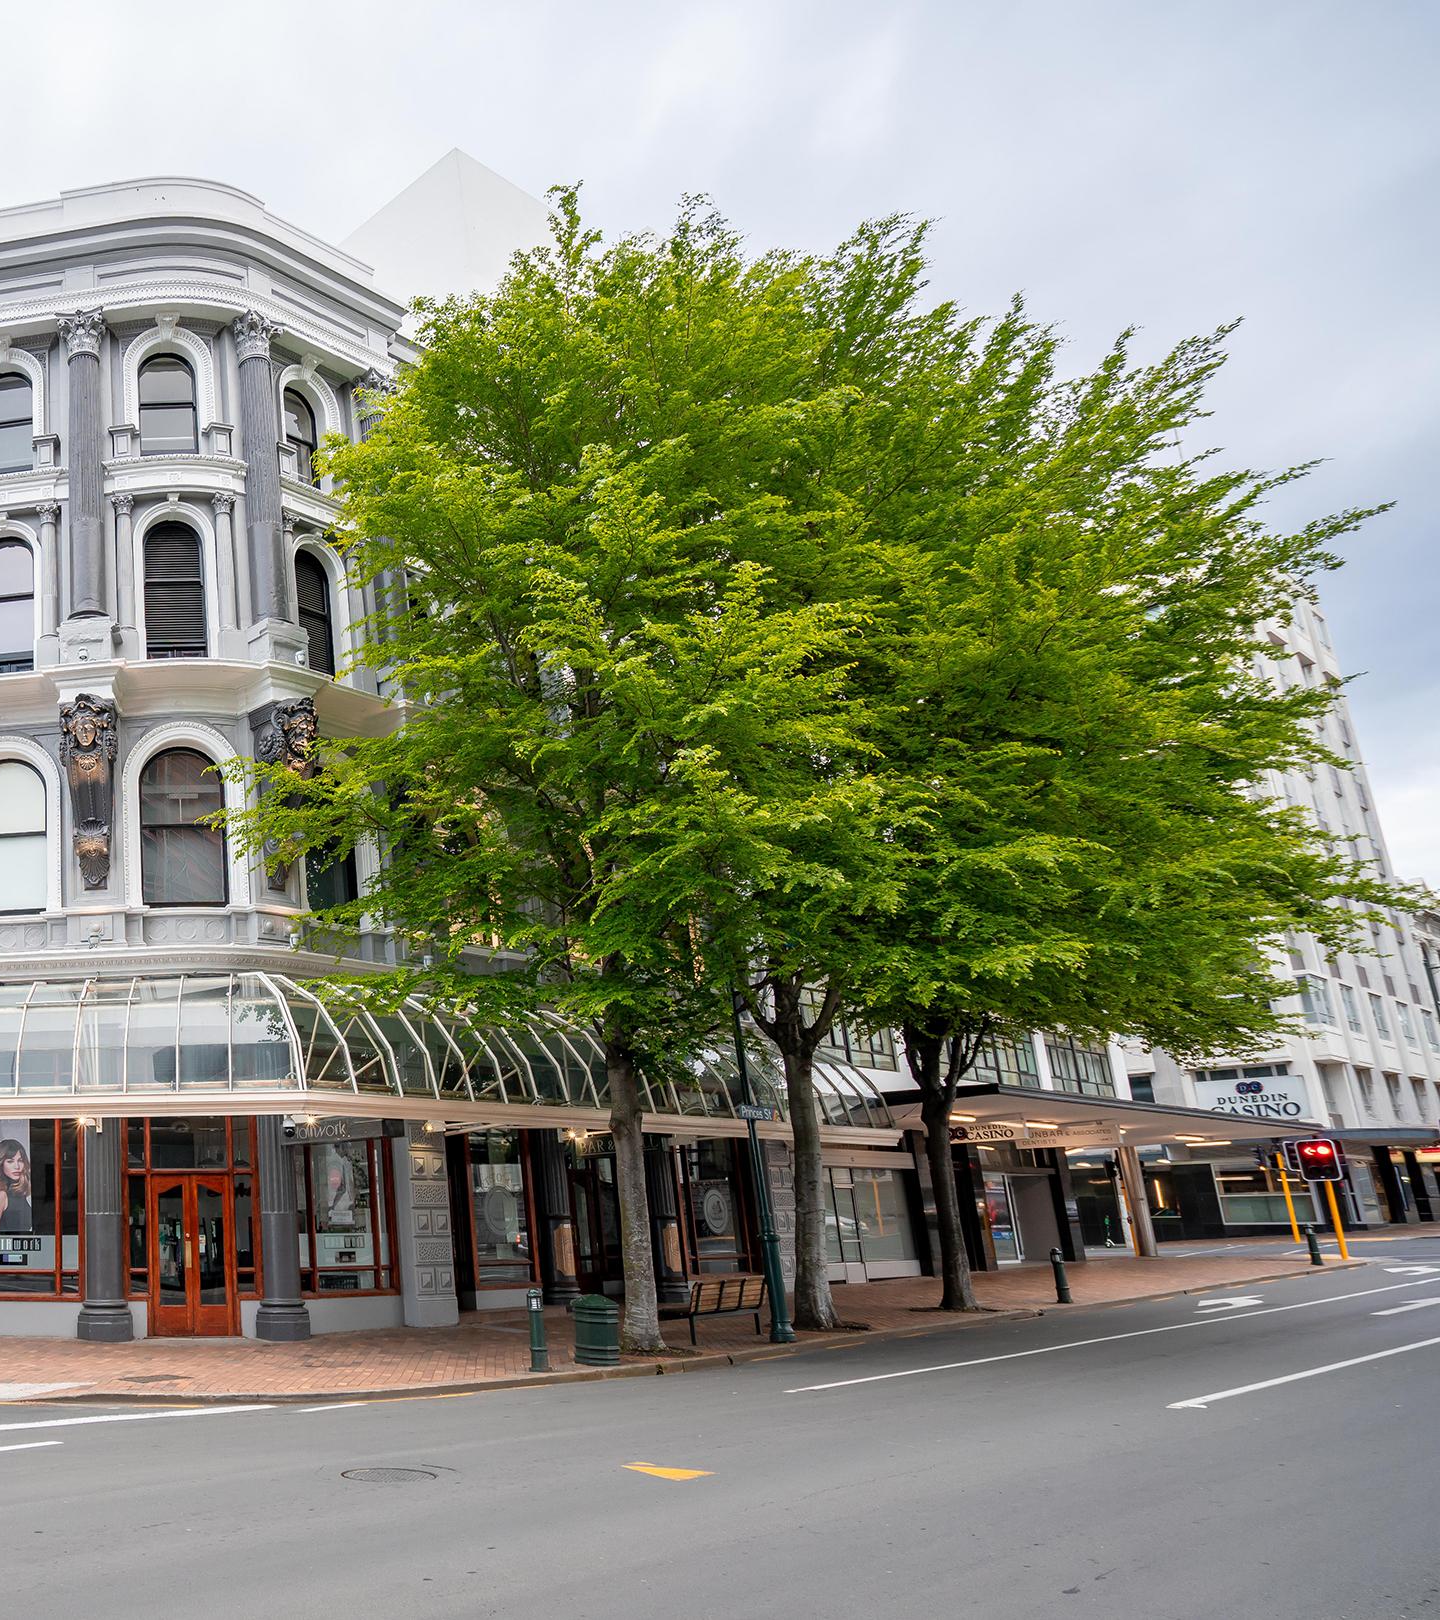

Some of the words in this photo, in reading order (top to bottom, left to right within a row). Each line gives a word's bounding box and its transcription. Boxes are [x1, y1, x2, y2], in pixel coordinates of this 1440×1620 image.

[1217, 1093, 1289, 1105] DUNEDIN
[741, 1105, 763, 1119] Princes
[764, 1108, 772, 1120] St
[967, 1129, 1013, 1141] CASINO
[1072, 1128, 1112, 1136] ASSOCIATES
[580, 1139, 605, 1154] BAR
[1022, 1138, 1057, 1146] DENTISTS
